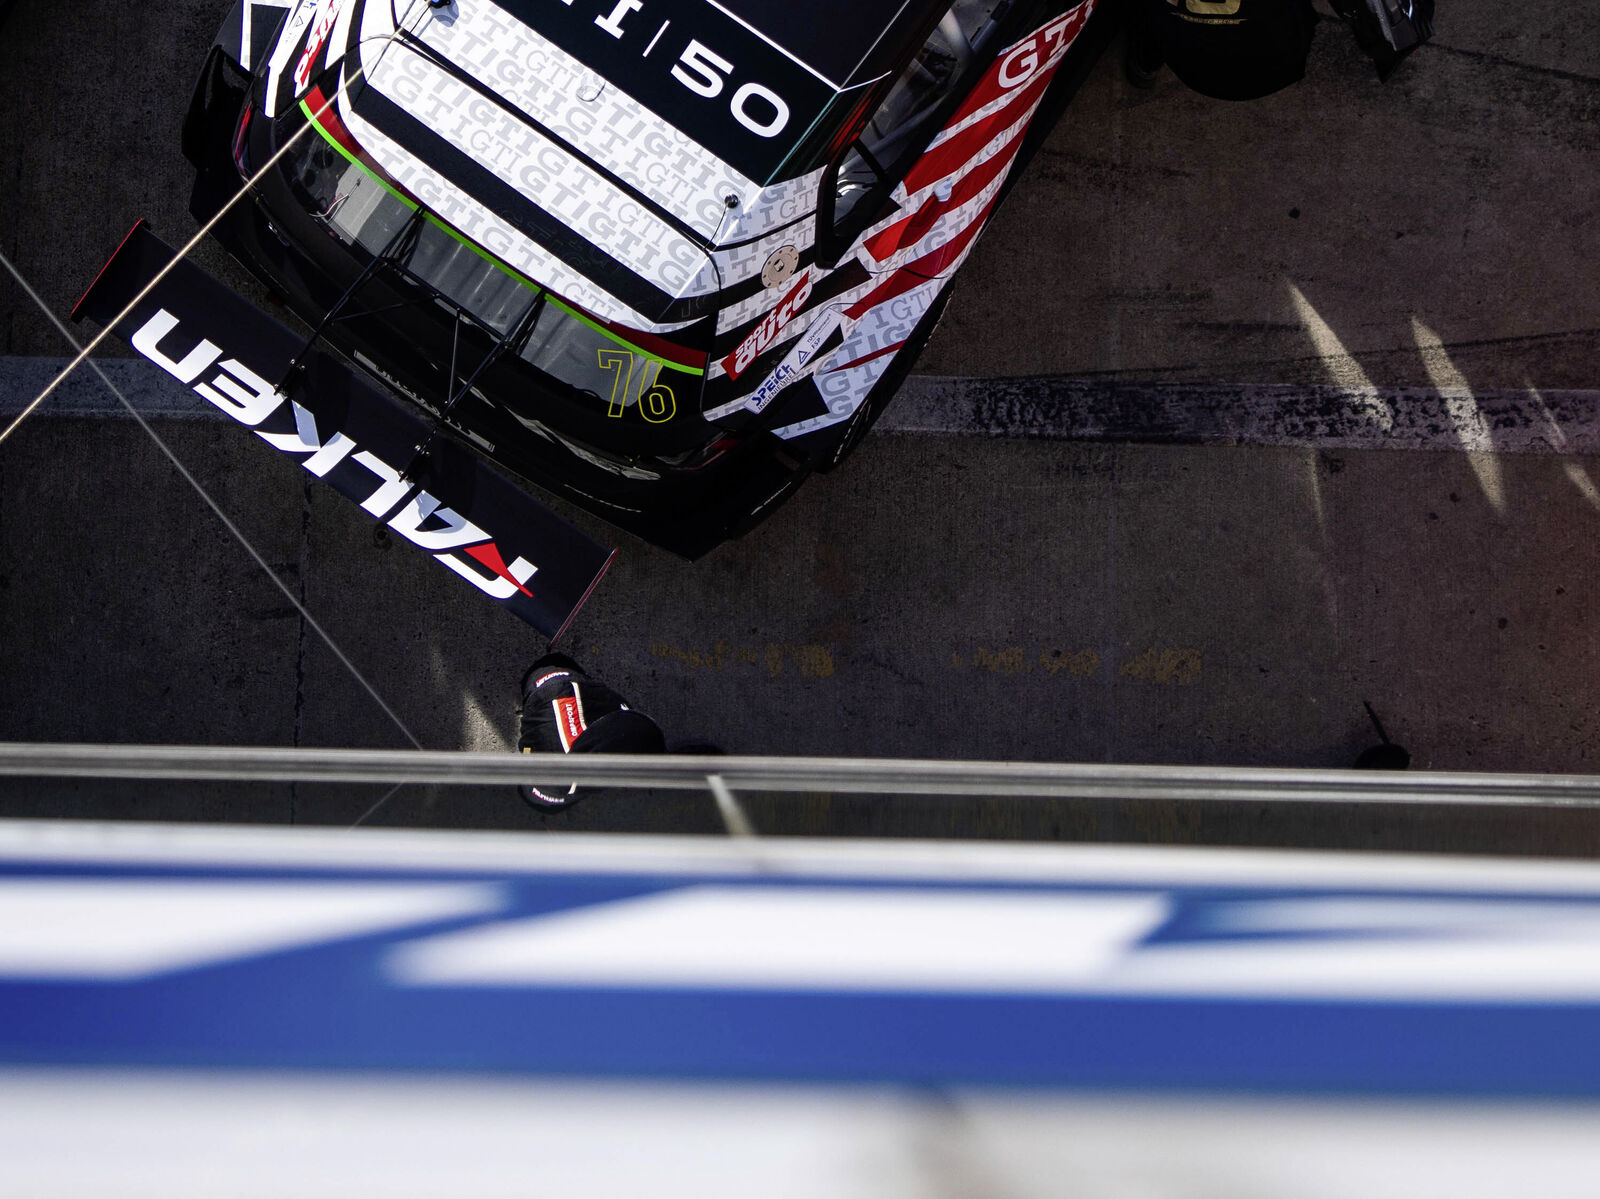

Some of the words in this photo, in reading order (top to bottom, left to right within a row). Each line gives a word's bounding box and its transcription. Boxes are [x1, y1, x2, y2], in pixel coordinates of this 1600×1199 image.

[670, 39, 790, 138] 50
[734, 283, 813, 373] auto
[734, 310, 777, 359] sport
[597, 349, 676, 422] 76
[130, 308, 538, 598] FALKEN
